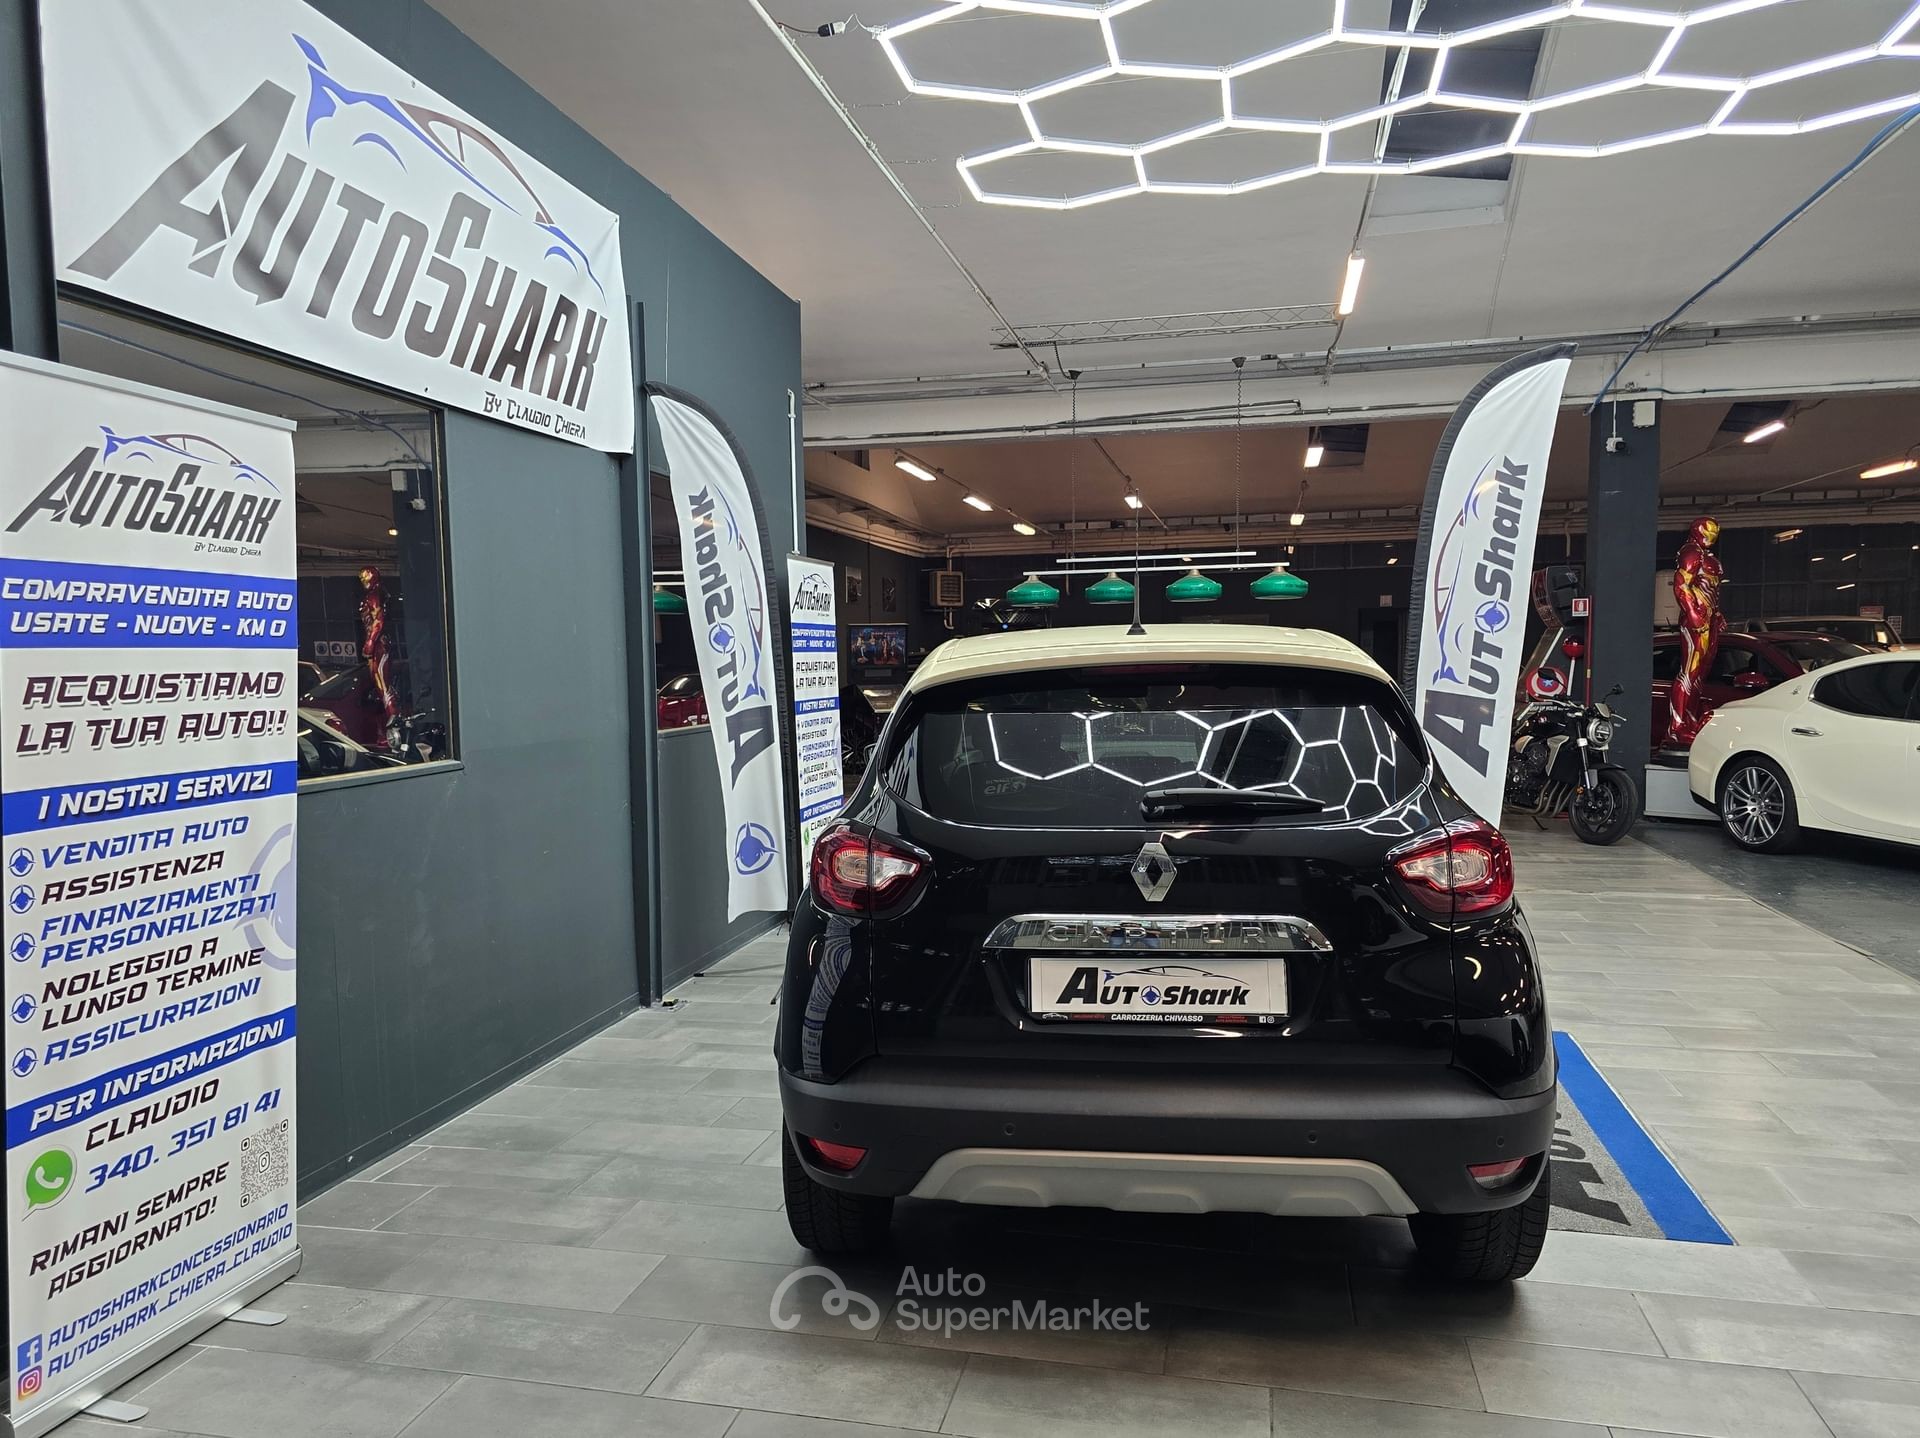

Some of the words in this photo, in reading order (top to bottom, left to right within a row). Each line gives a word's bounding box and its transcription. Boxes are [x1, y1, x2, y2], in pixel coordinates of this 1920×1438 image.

[506, 398, 552, 427] CLAUDIO
[554, 414, 586, 439] CHIERA
[2, 577, 230, 606] COMPRAVENDITA
[236, 590, 293, 611] AUTO
[10, 611, 109, 633] USATE
[134, 614, 216, 635] NUOVE
[22, 672, 285, 708] ACQUISTIAMO
[796, 661, 836, 673] ACQUISTIAMO
[16, 720, 74, 753] LA
[86, 715, 166, 748] TUA
[178, 709, 288, 740] AUTO!!
[38, 796, 49, 820] I
[57, 781, 168, 818] NOSTRI
[175, 769, 272, 801] SERVIZI
[41, 828, 174, 869] VENDITA
[182, 816, 249, 838] AUTO
[40, 873, 261, 941] FINANZIAMENTI
[41, 851, 224, 905] ASSISTENZA
[41, 892, 276, 969] PERSONALIZZATI
[41, 944, 193, 1004] NOLEGGIO
[200, 936, 219, 957] A
[42, 981, 148, 1032] LUNGO
[157, 946, 266, 997] TERMINE
[44, 976, 262, 1066] ASSICURAZIONI
[1111, 1013, 1164, 1022] CARROZZERIA
[1165, 1014, 1203, 1023] CHIVASSO
[29, 1088, 97, 1132] PER
[101, 1018, 286, 1105] INFORMAZIONI
[85, 1078, 220, 1152] CLAUDIO
[85, 1145, 159, 1194] 340.
[167, 1115, 217, 1157] 351
[222, 1102, 250, 1132] 81
[254, 1088, 282, 1113] 41
[29, 1210, 129, 1277] RIMANI
[135, 1161, 230, 1226] SEMPRE
[48, 1196, 218, 1300] AGGIORNATO!
[48, 1203, 289, 1352] AUTOSHARKCONCESSIONARIO
[48, 1222, 293, 1379] AUTOSHARK_CHIERA_CLAUDIO
